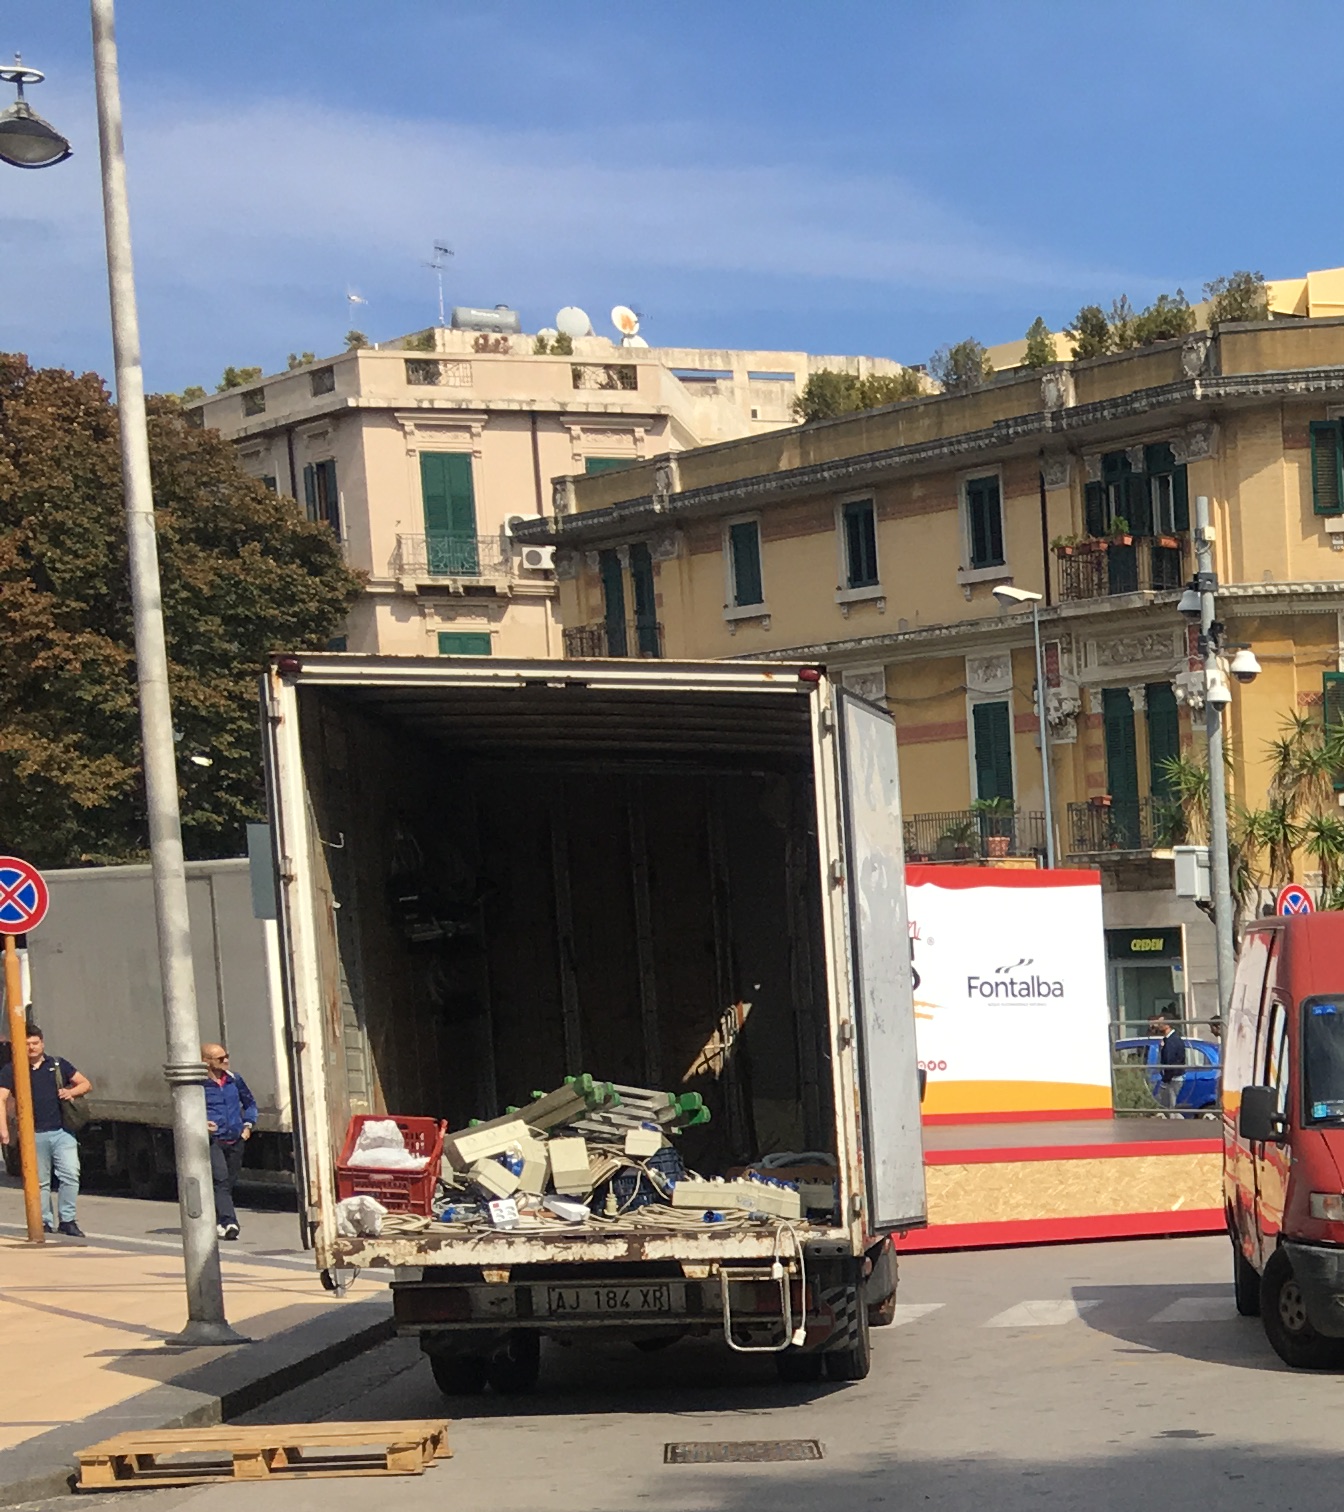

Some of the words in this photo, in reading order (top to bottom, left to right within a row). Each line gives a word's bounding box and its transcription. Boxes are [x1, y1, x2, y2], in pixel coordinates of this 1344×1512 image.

[1131, 938, 1164, 951] CREDEM
[967, 975, 1064, 998] Fontalba
[556, 1291, 580, 1310] AJ
[594, 1290, 631, 1309] 184
[640, 1289, 664, 1309] XR
